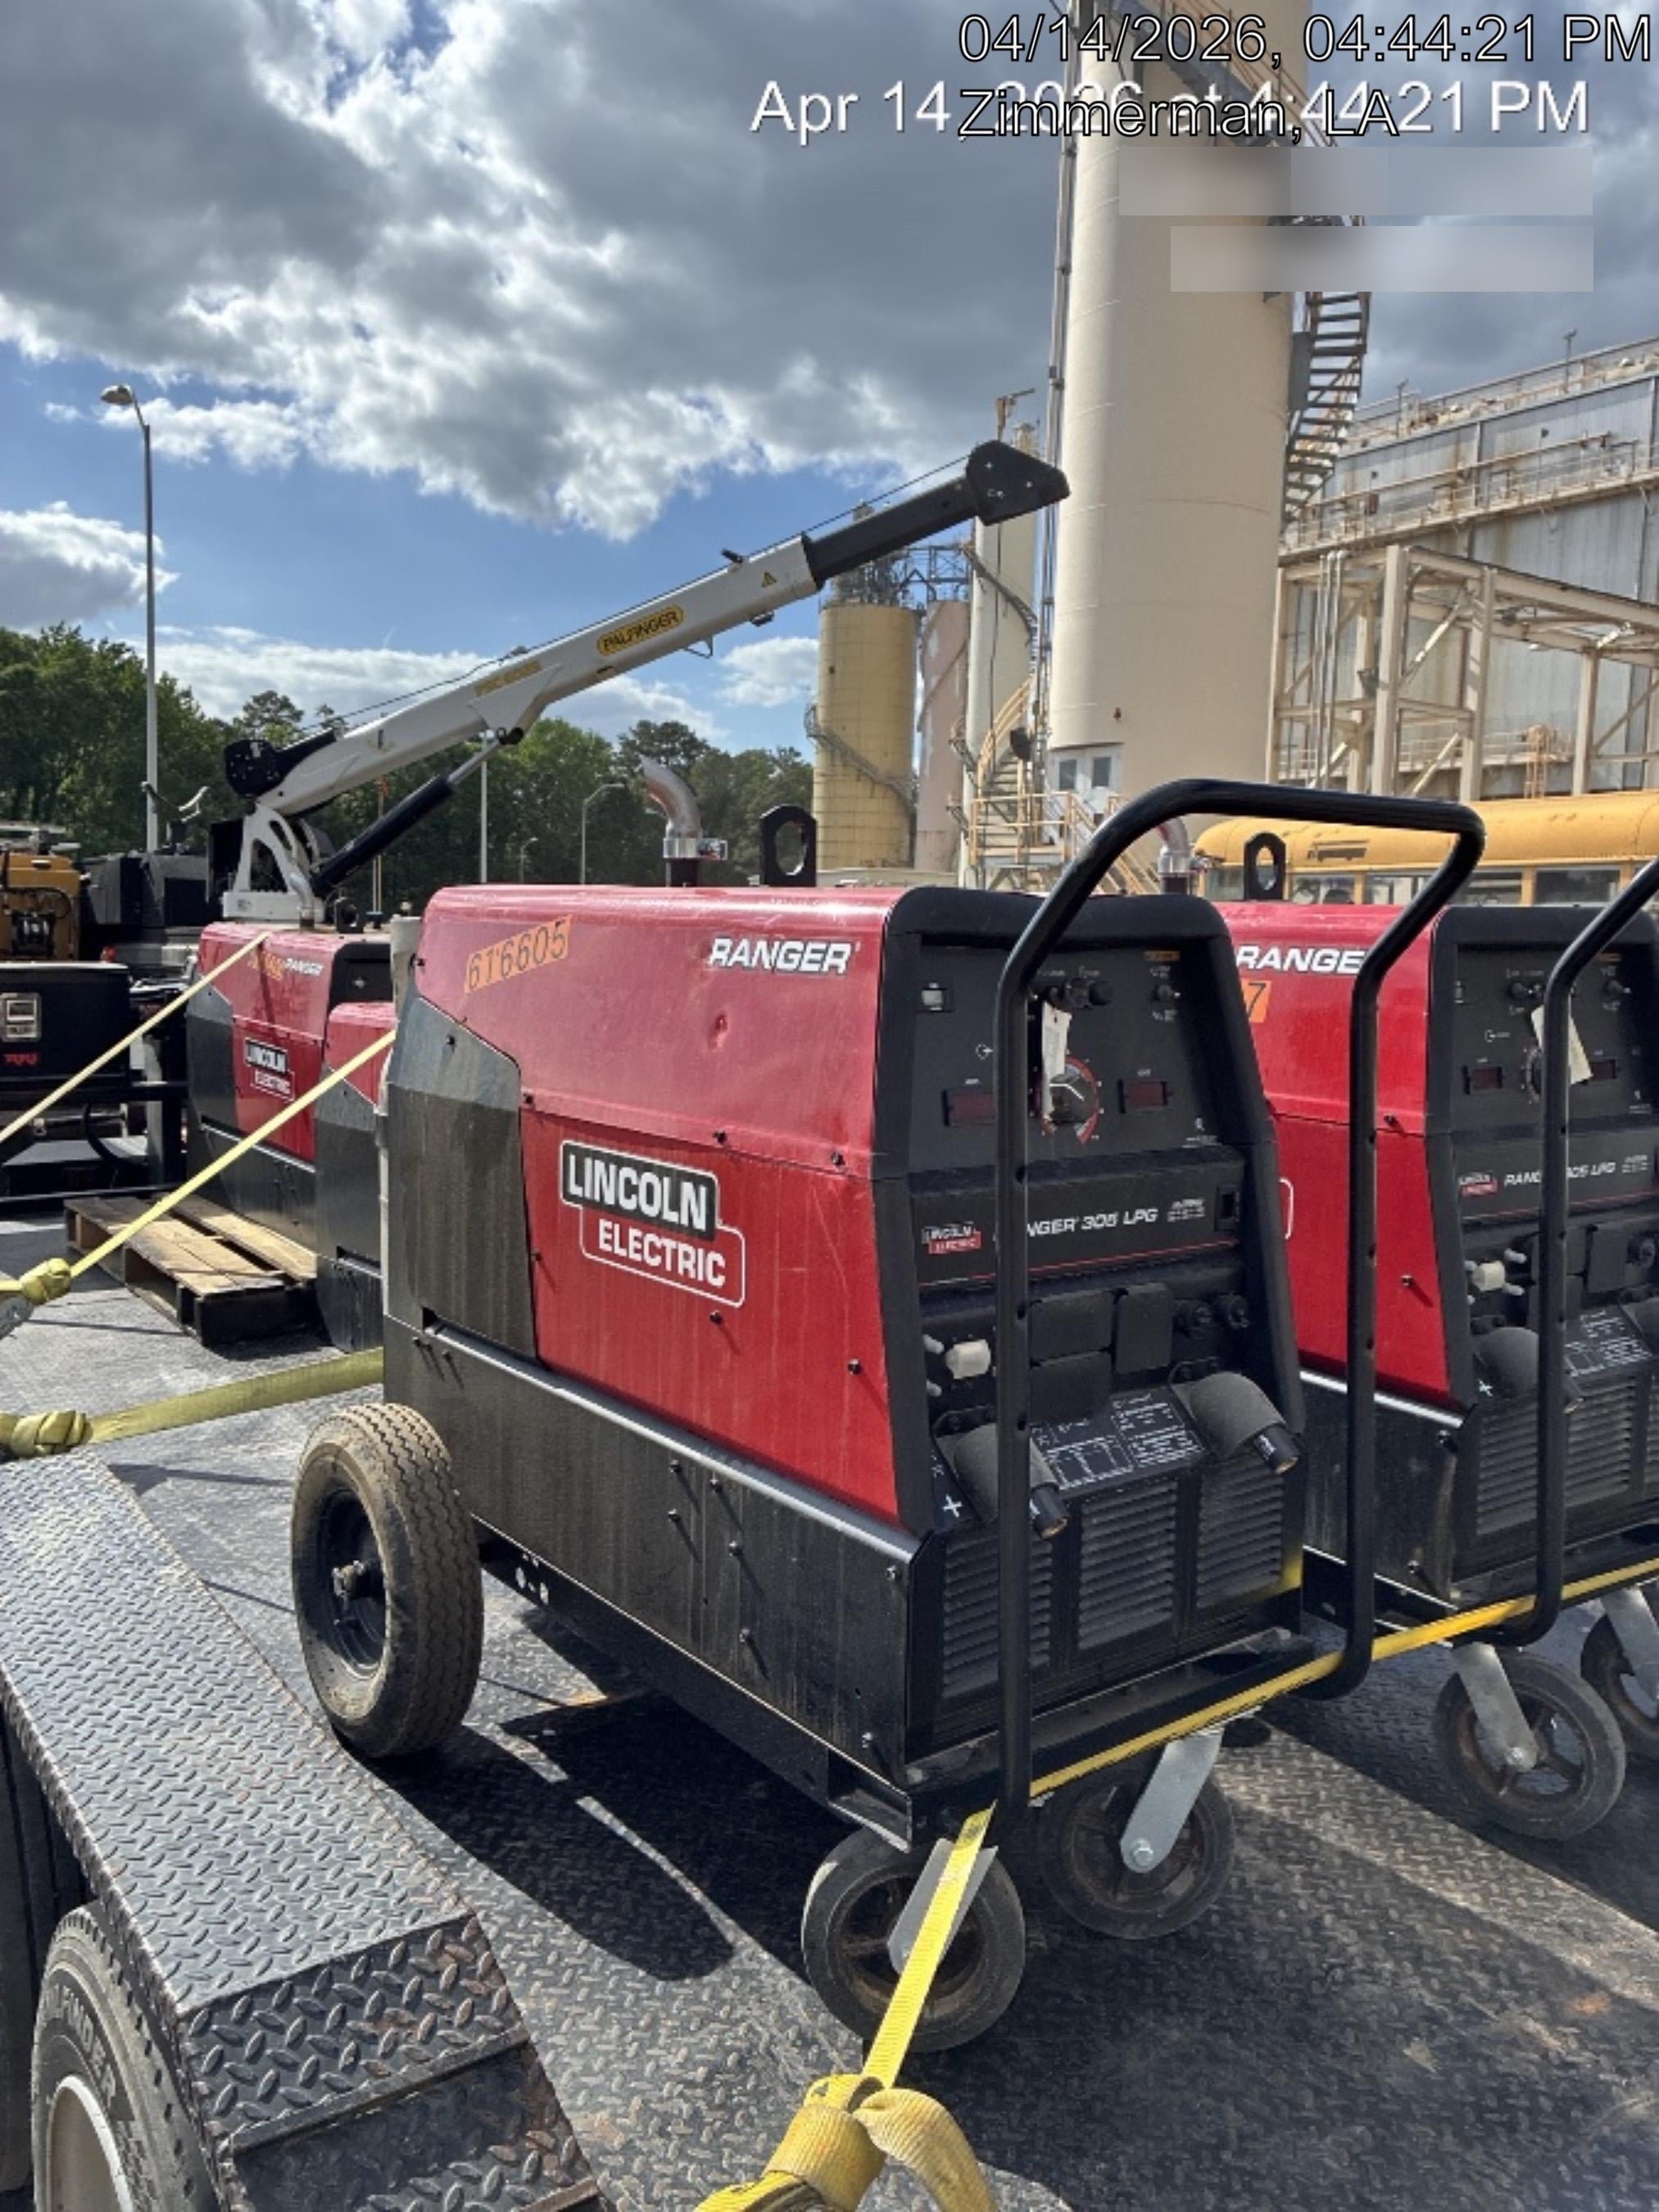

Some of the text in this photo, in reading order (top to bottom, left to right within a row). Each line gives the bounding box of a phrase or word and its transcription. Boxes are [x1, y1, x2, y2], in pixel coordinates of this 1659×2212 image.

[468, 918, 567, 989] 616605
[707, 936, 853, 975] RANGER
[1235, 945, 1367, 975] RANGE
[567, 1153, 708, 1232] LINCOLN
[1081, 1212, 1118, 1231] 305
[1122, 1208, 1158, 1226] LPG
[599, 1218, 726, 1288] ELECTRIC
